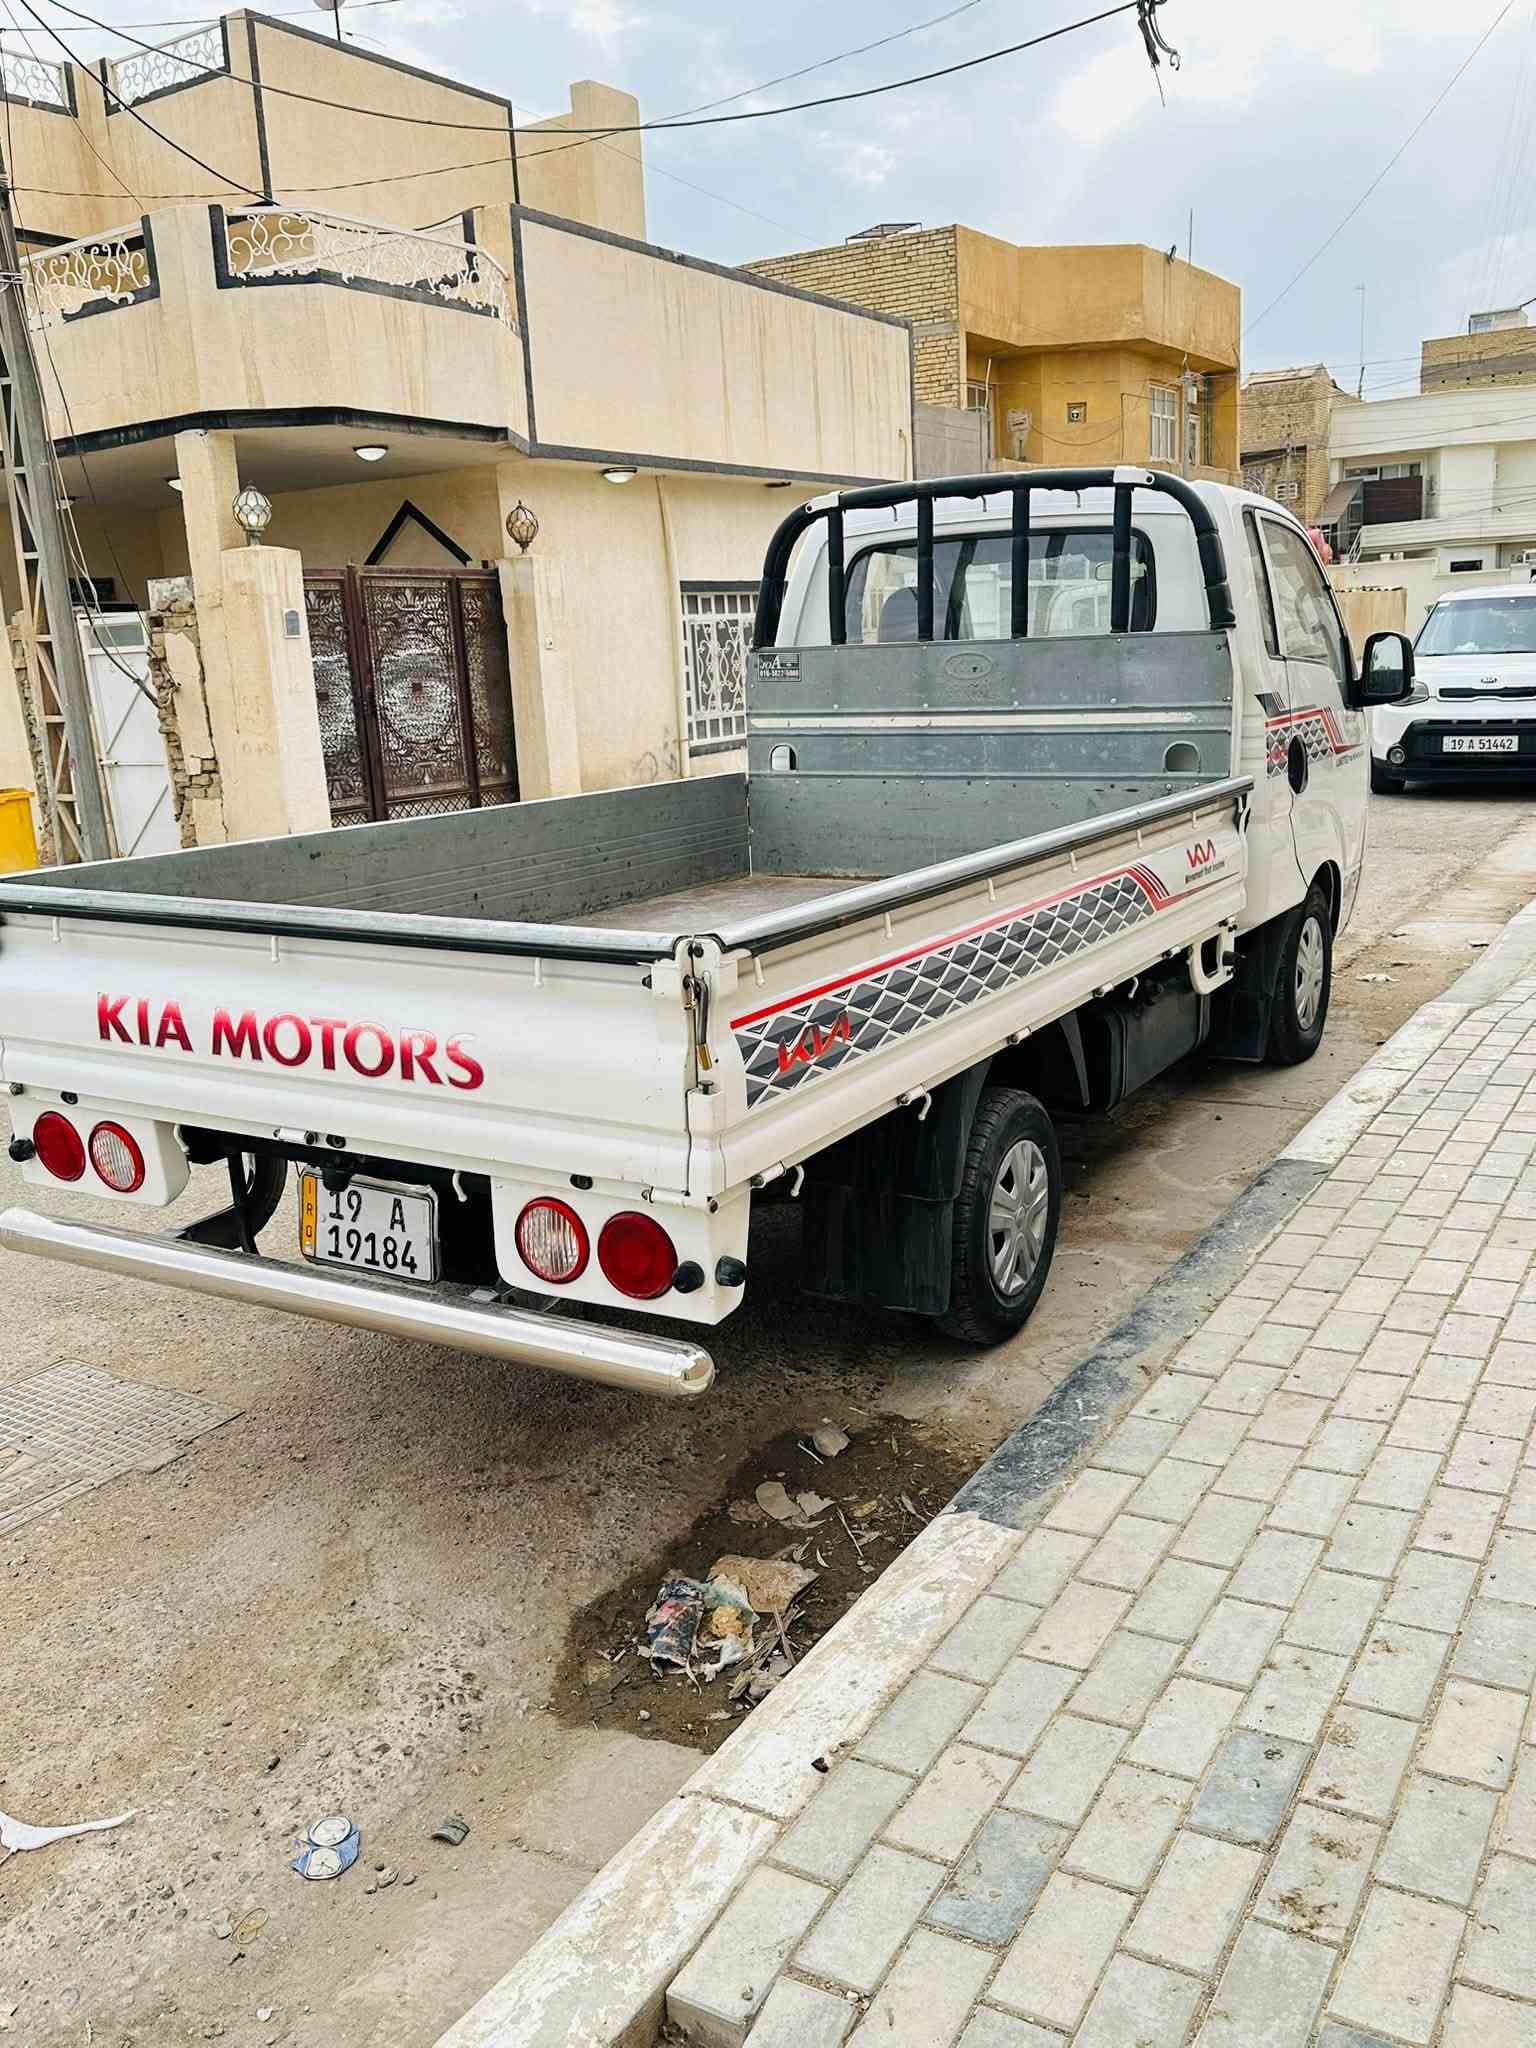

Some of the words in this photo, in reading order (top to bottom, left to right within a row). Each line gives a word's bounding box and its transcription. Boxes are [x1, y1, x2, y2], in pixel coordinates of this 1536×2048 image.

[1451, 738, 1465, 751] 19
[1468, 738, 1475, 751] A
[1479, 738, 1513, 751] 51442
[97, 991, 194, 1053] KIA
[211, 1005, 484, 1091] MOTORS
[777, 1010, 851, 1073] KIA
[328, 1189, 362, 1223] 19
[389, 1197, 406, 1233] A
[327, 1224, 418, 1274] 19184
